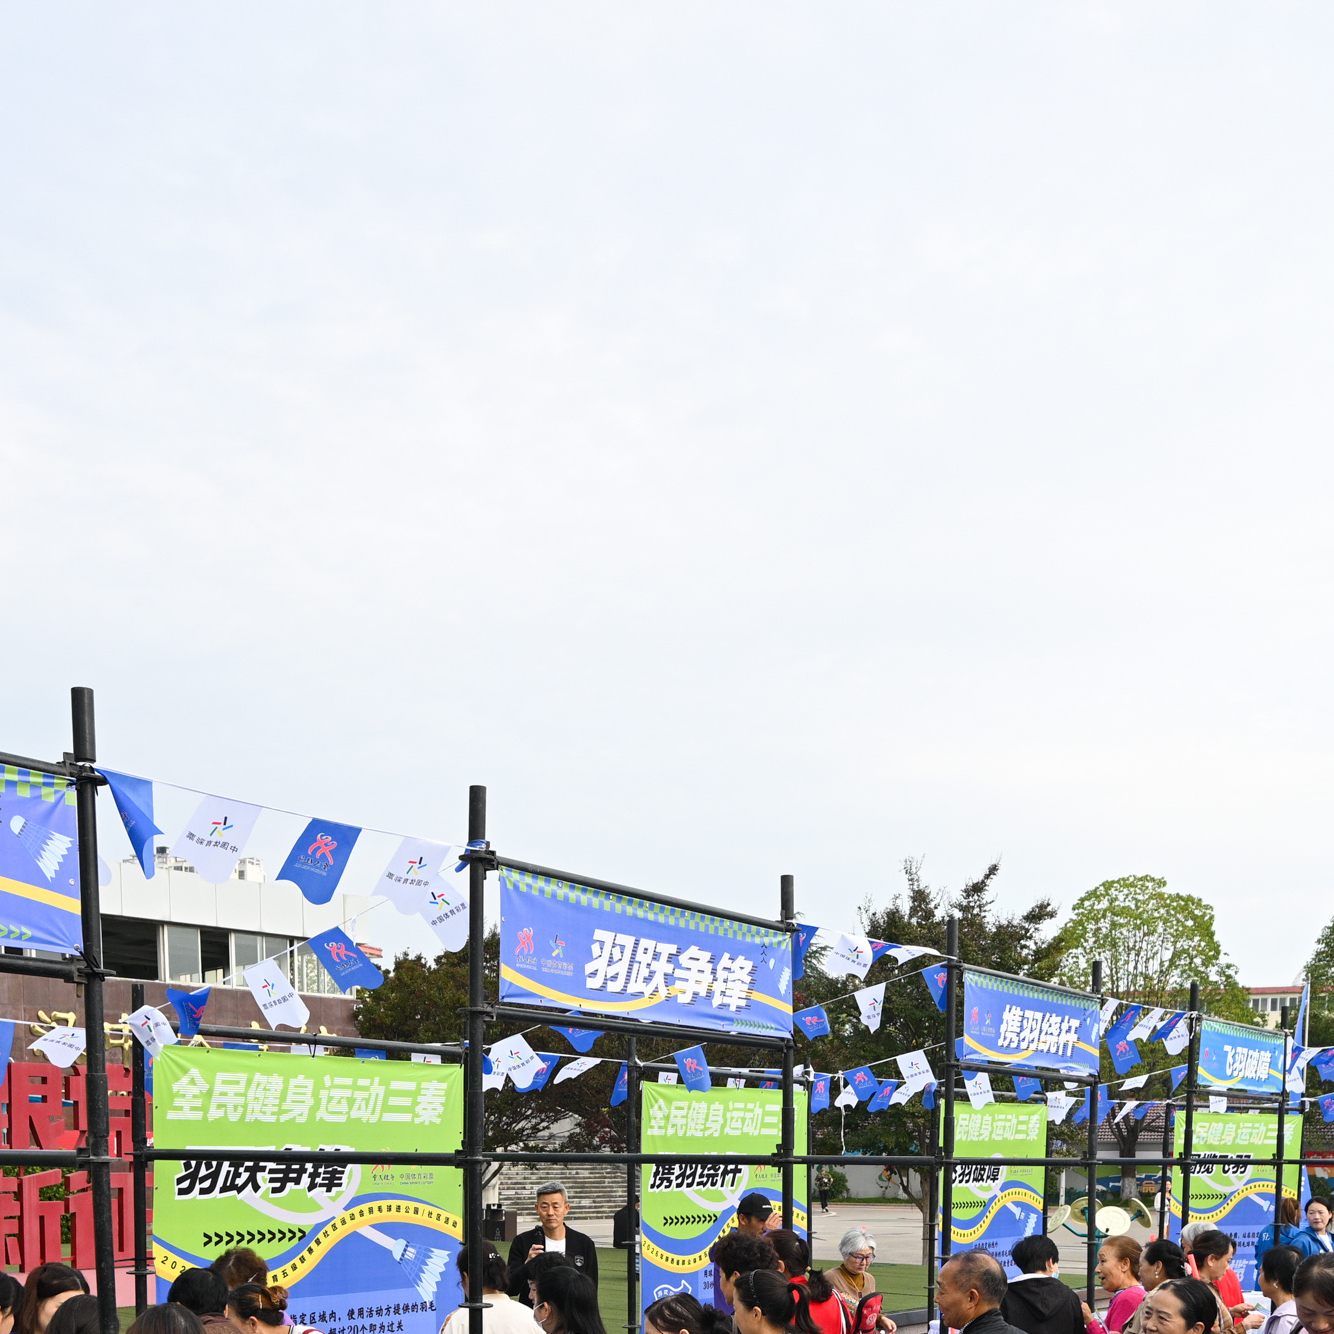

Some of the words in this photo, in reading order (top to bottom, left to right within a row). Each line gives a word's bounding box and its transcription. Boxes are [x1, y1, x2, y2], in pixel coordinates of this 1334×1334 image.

[431, 902, 468, 927] 中国体育彩票
[585, 928, 754, 1012] 羽跃争锋
[998, 1004, 1081, 1058] 携羽绕杆
[1223, 1044, 1272, 1082] 飞羽破障
[166, 1068, 448, 1125] 全民健身运动三秦
[647, 1099, 797, 1137] 全民健身运动三
[954, 1114, 1041, 1141] 民健身运动三秦
